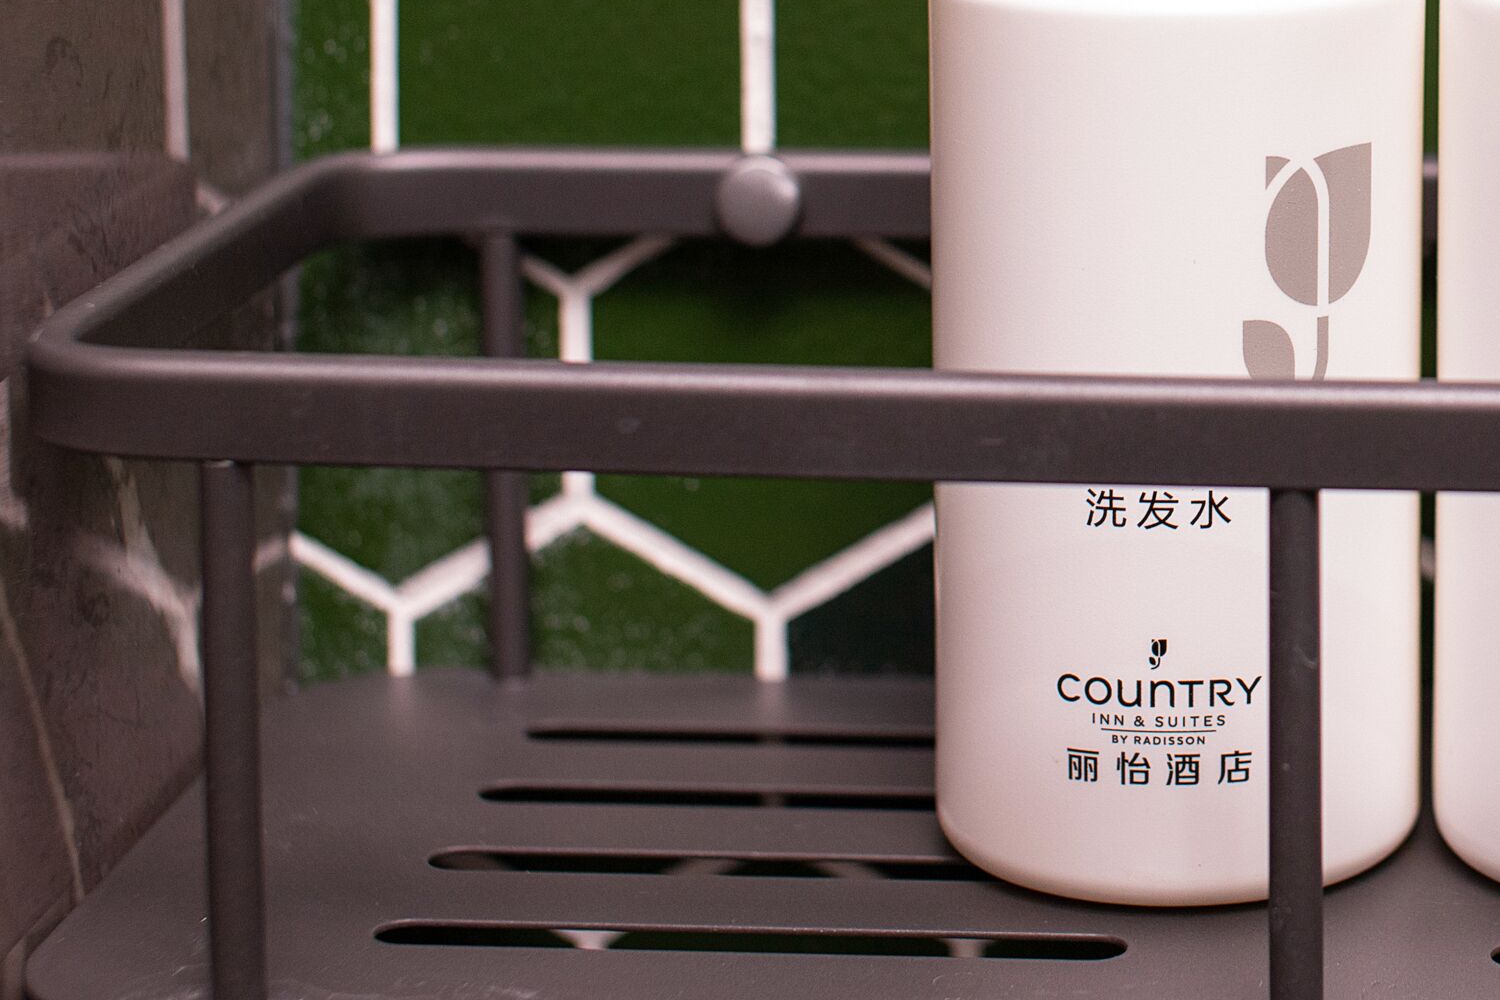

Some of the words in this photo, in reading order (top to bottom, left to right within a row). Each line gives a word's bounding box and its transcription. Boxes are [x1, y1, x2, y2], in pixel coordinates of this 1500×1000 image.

[1085, 488, 1232, 530] 洗发水
[1091, 712, 1125, 726] INN
[1133, 715, 1145, 728] &
[1154, 714, 1226, 728] SUITES
[1111, 734, 1129, 745] BY
[1133, 735, 1206, 746] RADISSON
[1066, 747, 1253, 786] 丽怡酒店
